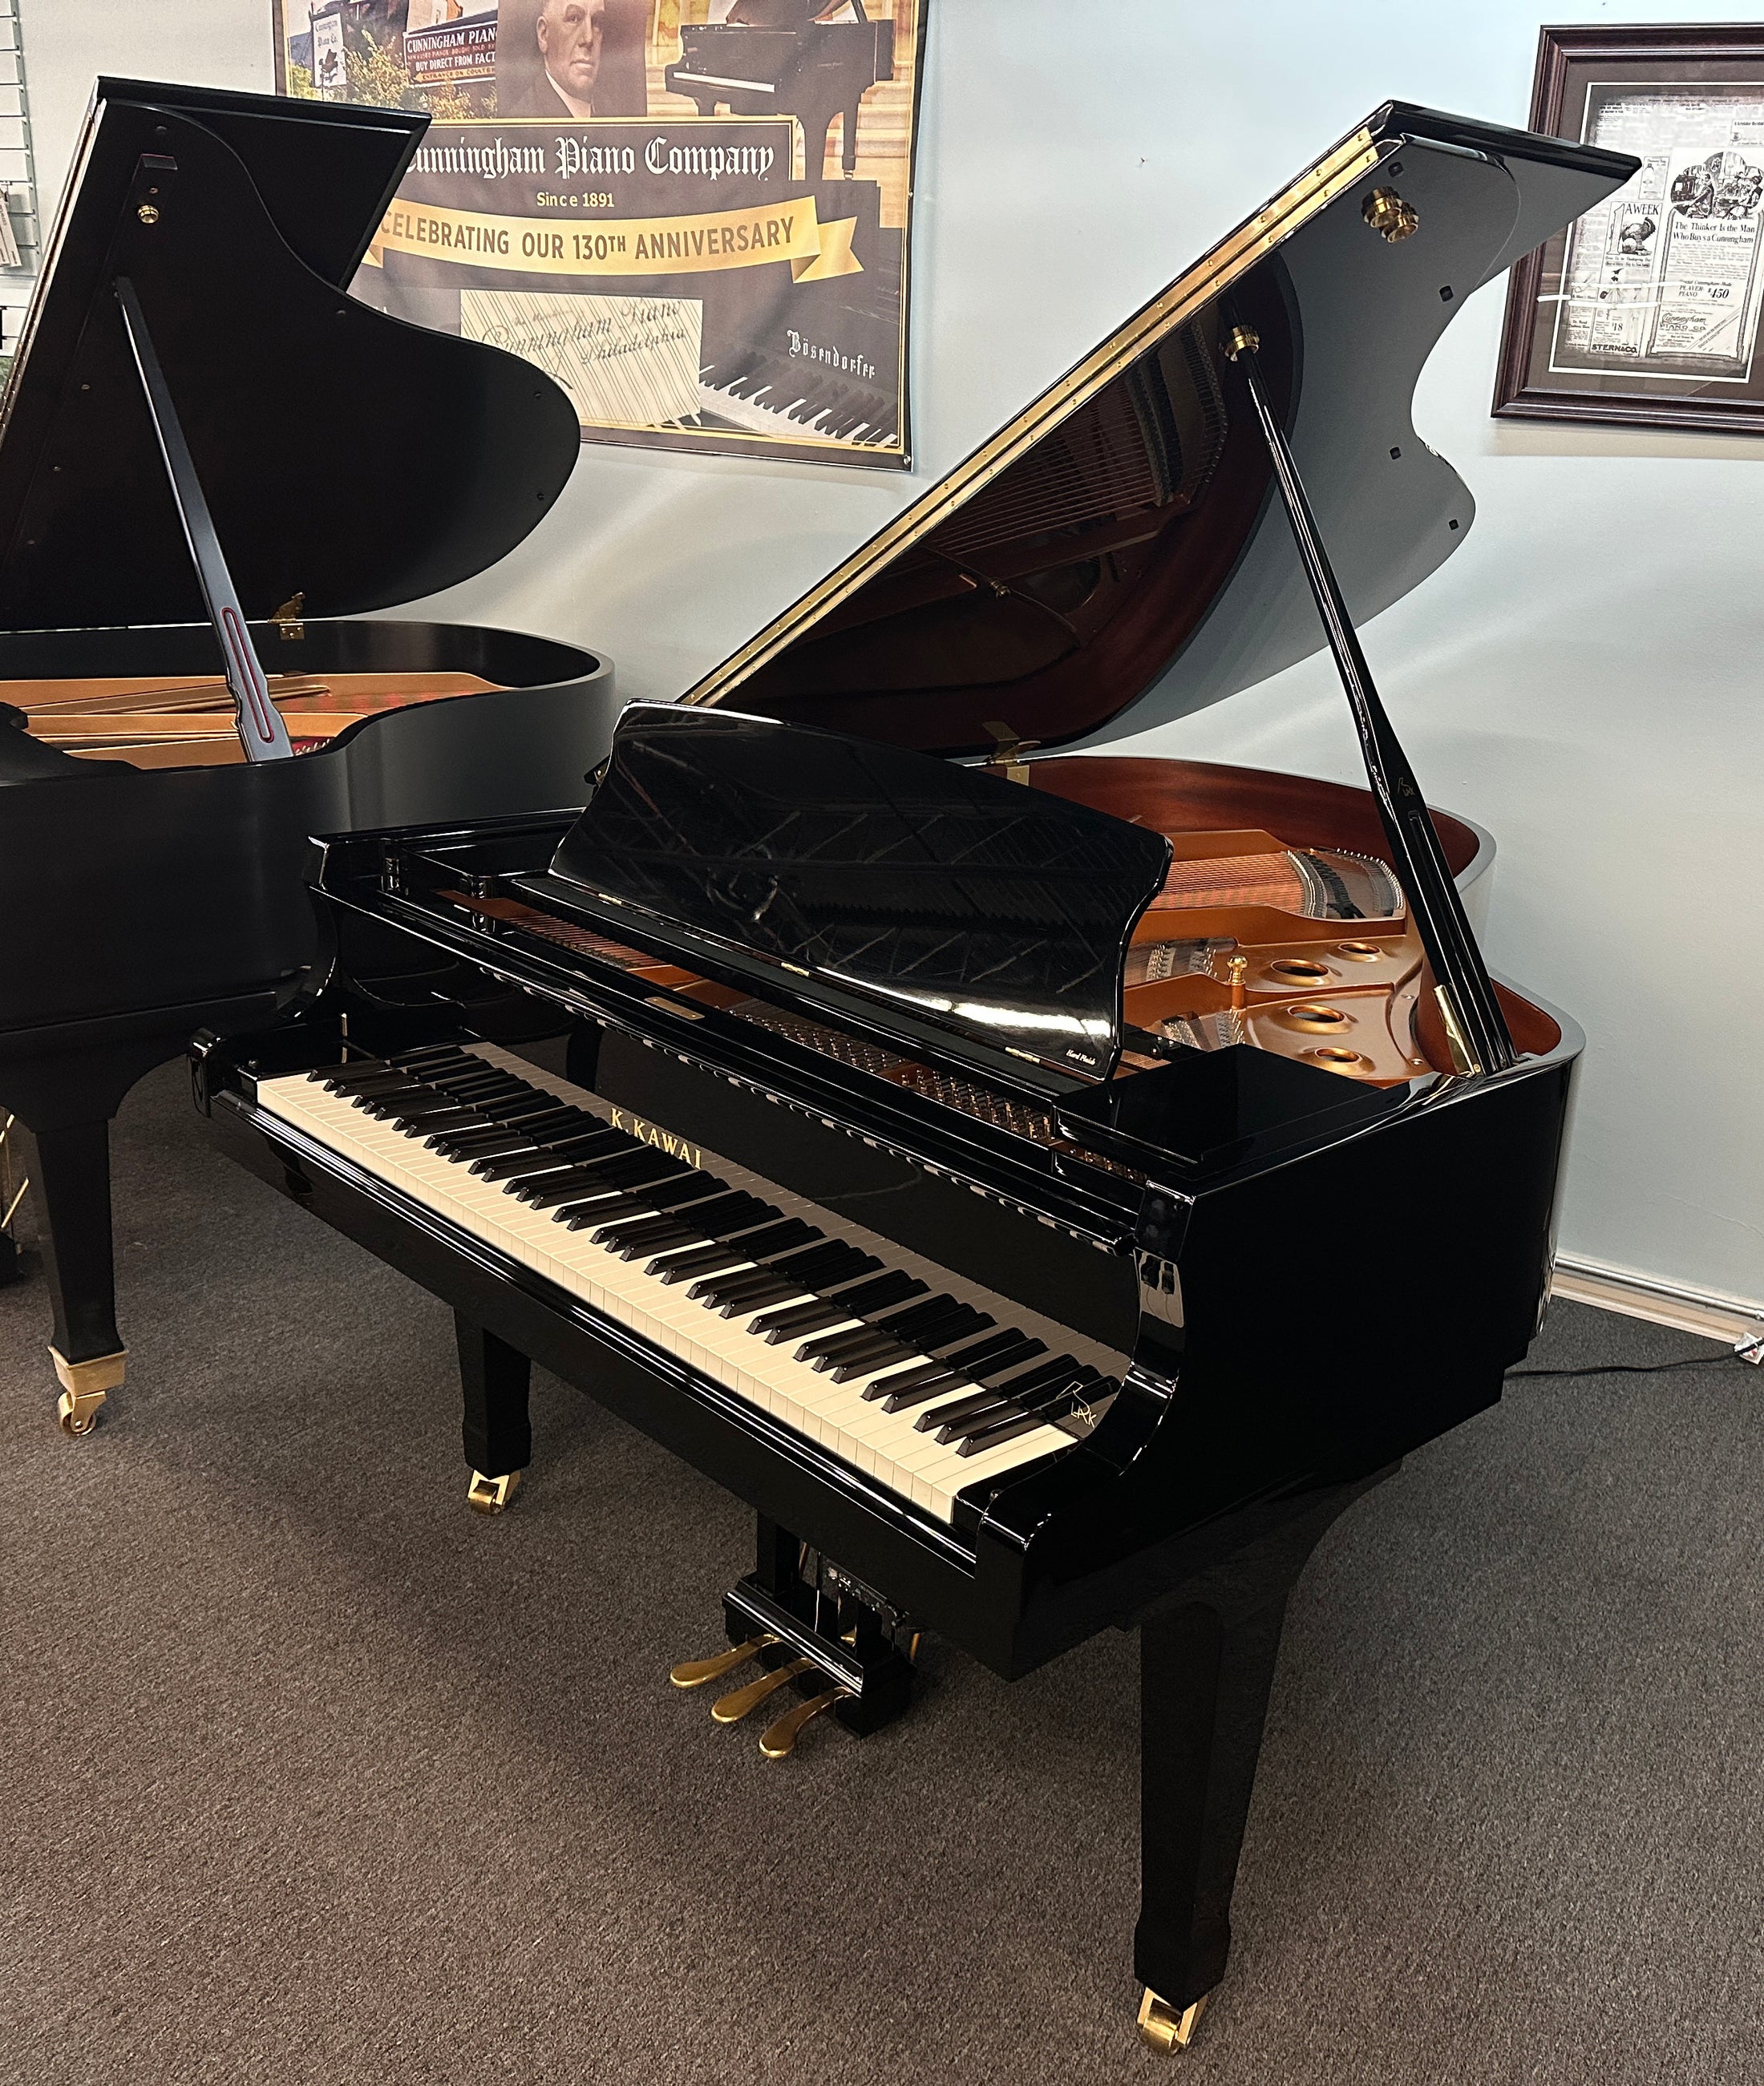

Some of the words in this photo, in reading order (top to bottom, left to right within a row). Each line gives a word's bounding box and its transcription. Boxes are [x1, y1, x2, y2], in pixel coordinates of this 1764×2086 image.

[407, 32, 465, 53] CUNNINGHAM
[468, 27, 497, 44] PIAN
[415, 60, 428, 71] BUY
[429, 57, 453, 70] DIRECT
[454, 54, 472, 67] FROM
[475, 51, 496, 64] FACT
[555, 136, 636, 179] Piano
[645, 136, 775, 181] Company
[536, 192, 578, 207] Since
[582, 192, 614, 208] 1891
[1633, 203, 1660, 216] WEEK
[381, 211, 509, 255] CELEBRATING
[522, 232, 564, 259] OUR
[572, 234, 626, 261] 130TH
[634, 216, 794, 261] ANNIVERSARY
[1675, 221, 1688, 230] The
[1690, 222, 1717, 232] Thinker
[1719, 223, 1726, 232] Is
[1726, 224, 1738, 232] the
[1740, 224, 1755, 233] Man
[1673, 232, 1689, 241] Who
[1689, 232, 1706, 243] Buys
[1712, 233, 1754, 245] Cunningham
[1707, 288, 1730, 299] $450
[581, 327, 686, 364] Philadelphia
[787, 329, 876, 379] Bösendorfer
